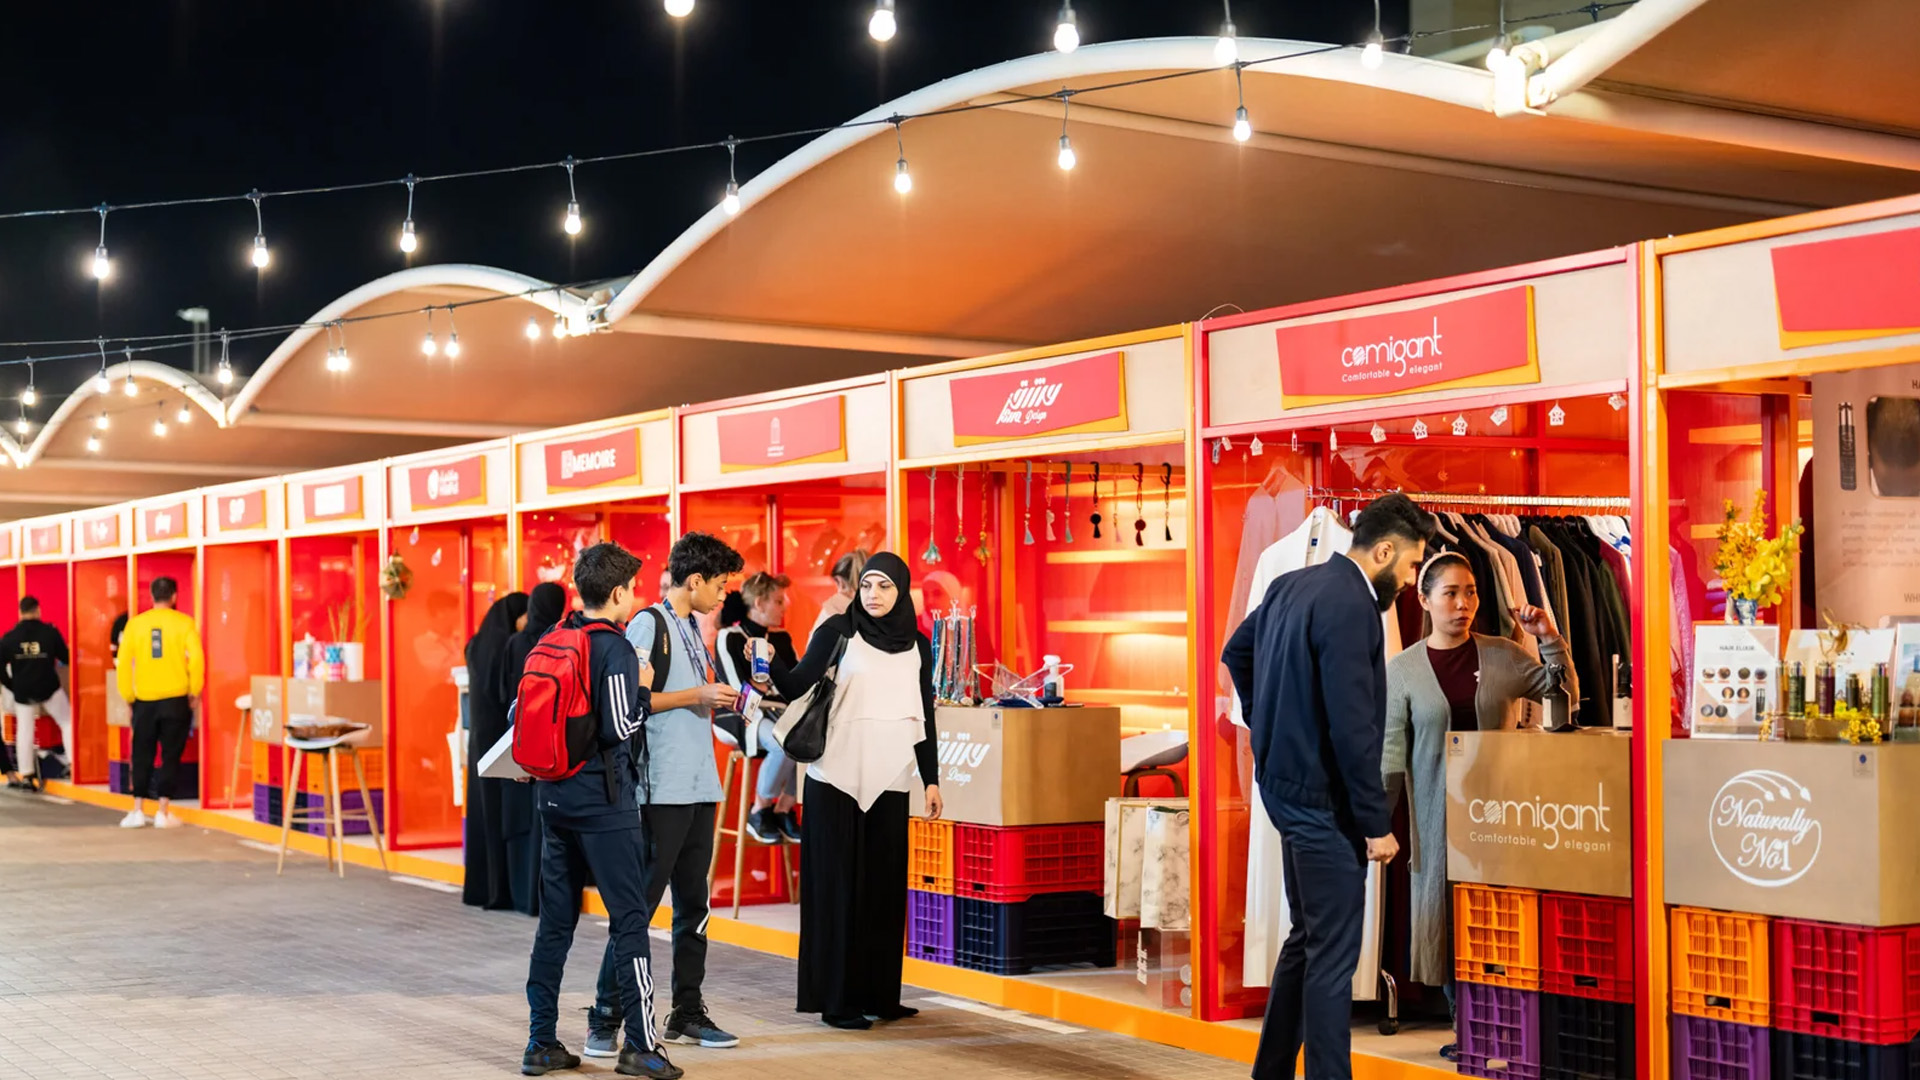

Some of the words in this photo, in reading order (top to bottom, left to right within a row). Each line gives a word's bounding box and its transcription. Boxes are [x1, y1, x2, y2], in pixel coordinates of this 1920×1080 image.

[1341, 316, 1442, 378] comigant
[1342, 369, 1390, 383] Comfortable
[1409, 361, 1443, 376] elegant
[1469, 782, 1611, 850] comigant
[1717, 795, 1812, 845] Naturally
[1469, 831, 1537, 847] Comfortable
[1564, 840, 1611, 852] elegant
